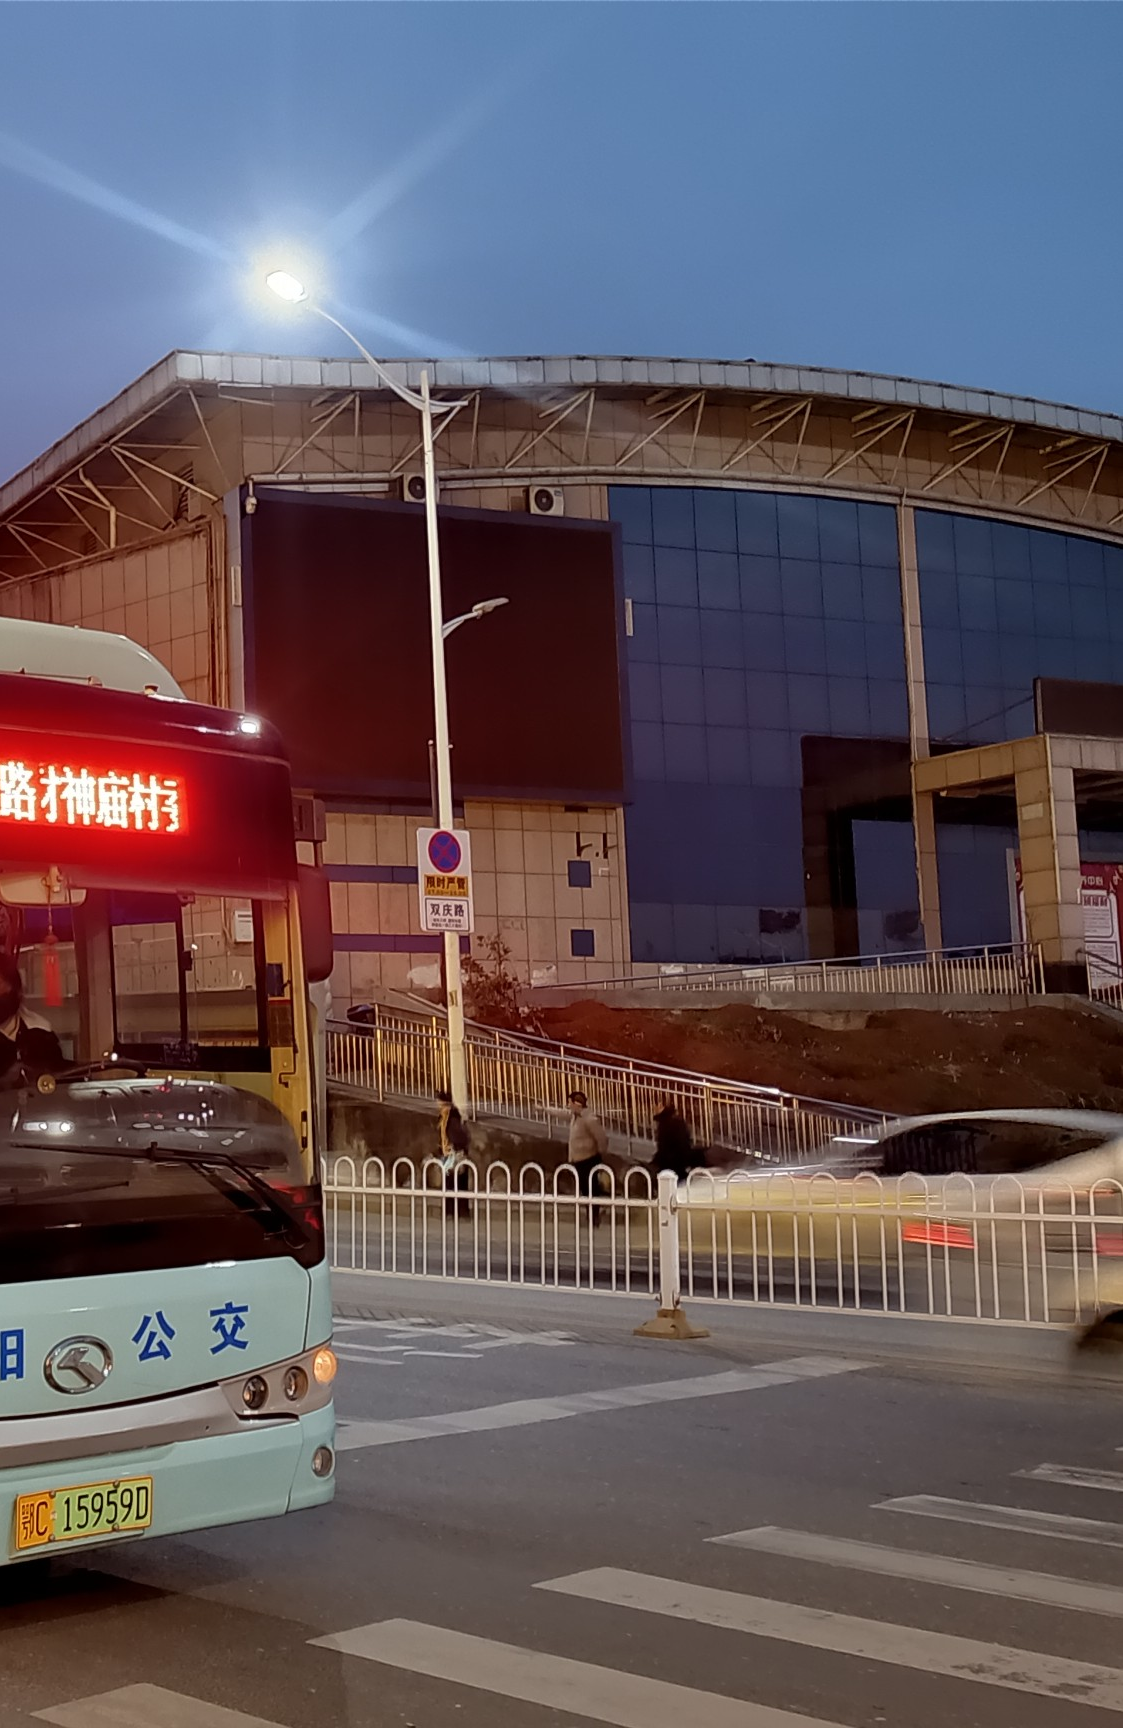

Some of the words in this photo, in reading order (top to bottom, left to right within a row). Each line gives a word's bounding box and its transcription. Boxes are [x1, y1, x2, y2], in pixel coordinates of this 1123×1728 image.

[429, 903, 464, 917] 双庆路
[131, 1302, 250, 1363] 公交
